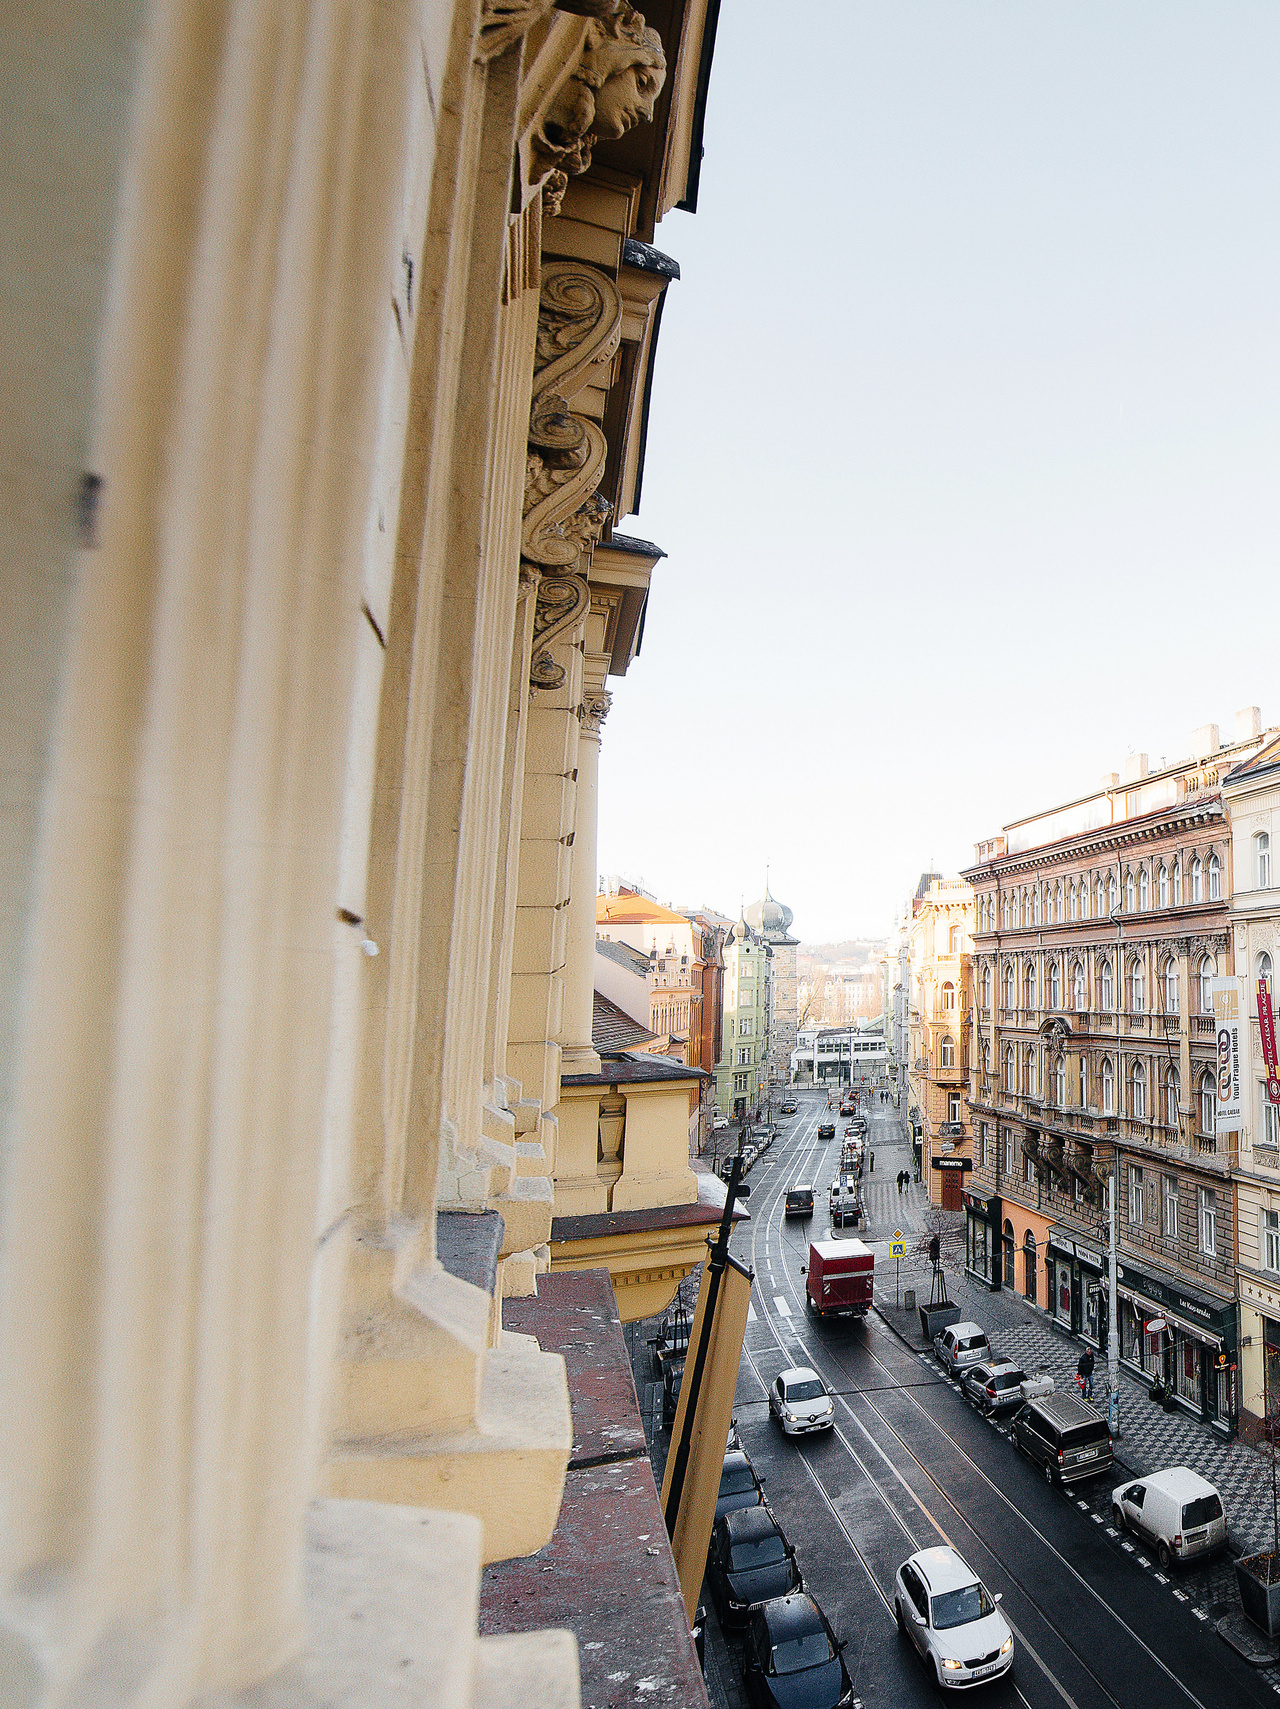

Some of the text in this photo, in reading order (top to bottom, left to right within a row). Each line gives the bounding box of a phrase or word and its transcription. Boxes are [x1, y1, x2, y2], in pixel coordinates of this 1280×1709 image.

[1231, 1027, 1239, 1053] Hotels
[1260, 983, 1276, 1077] HOTEL CAESAR PRAGUE
